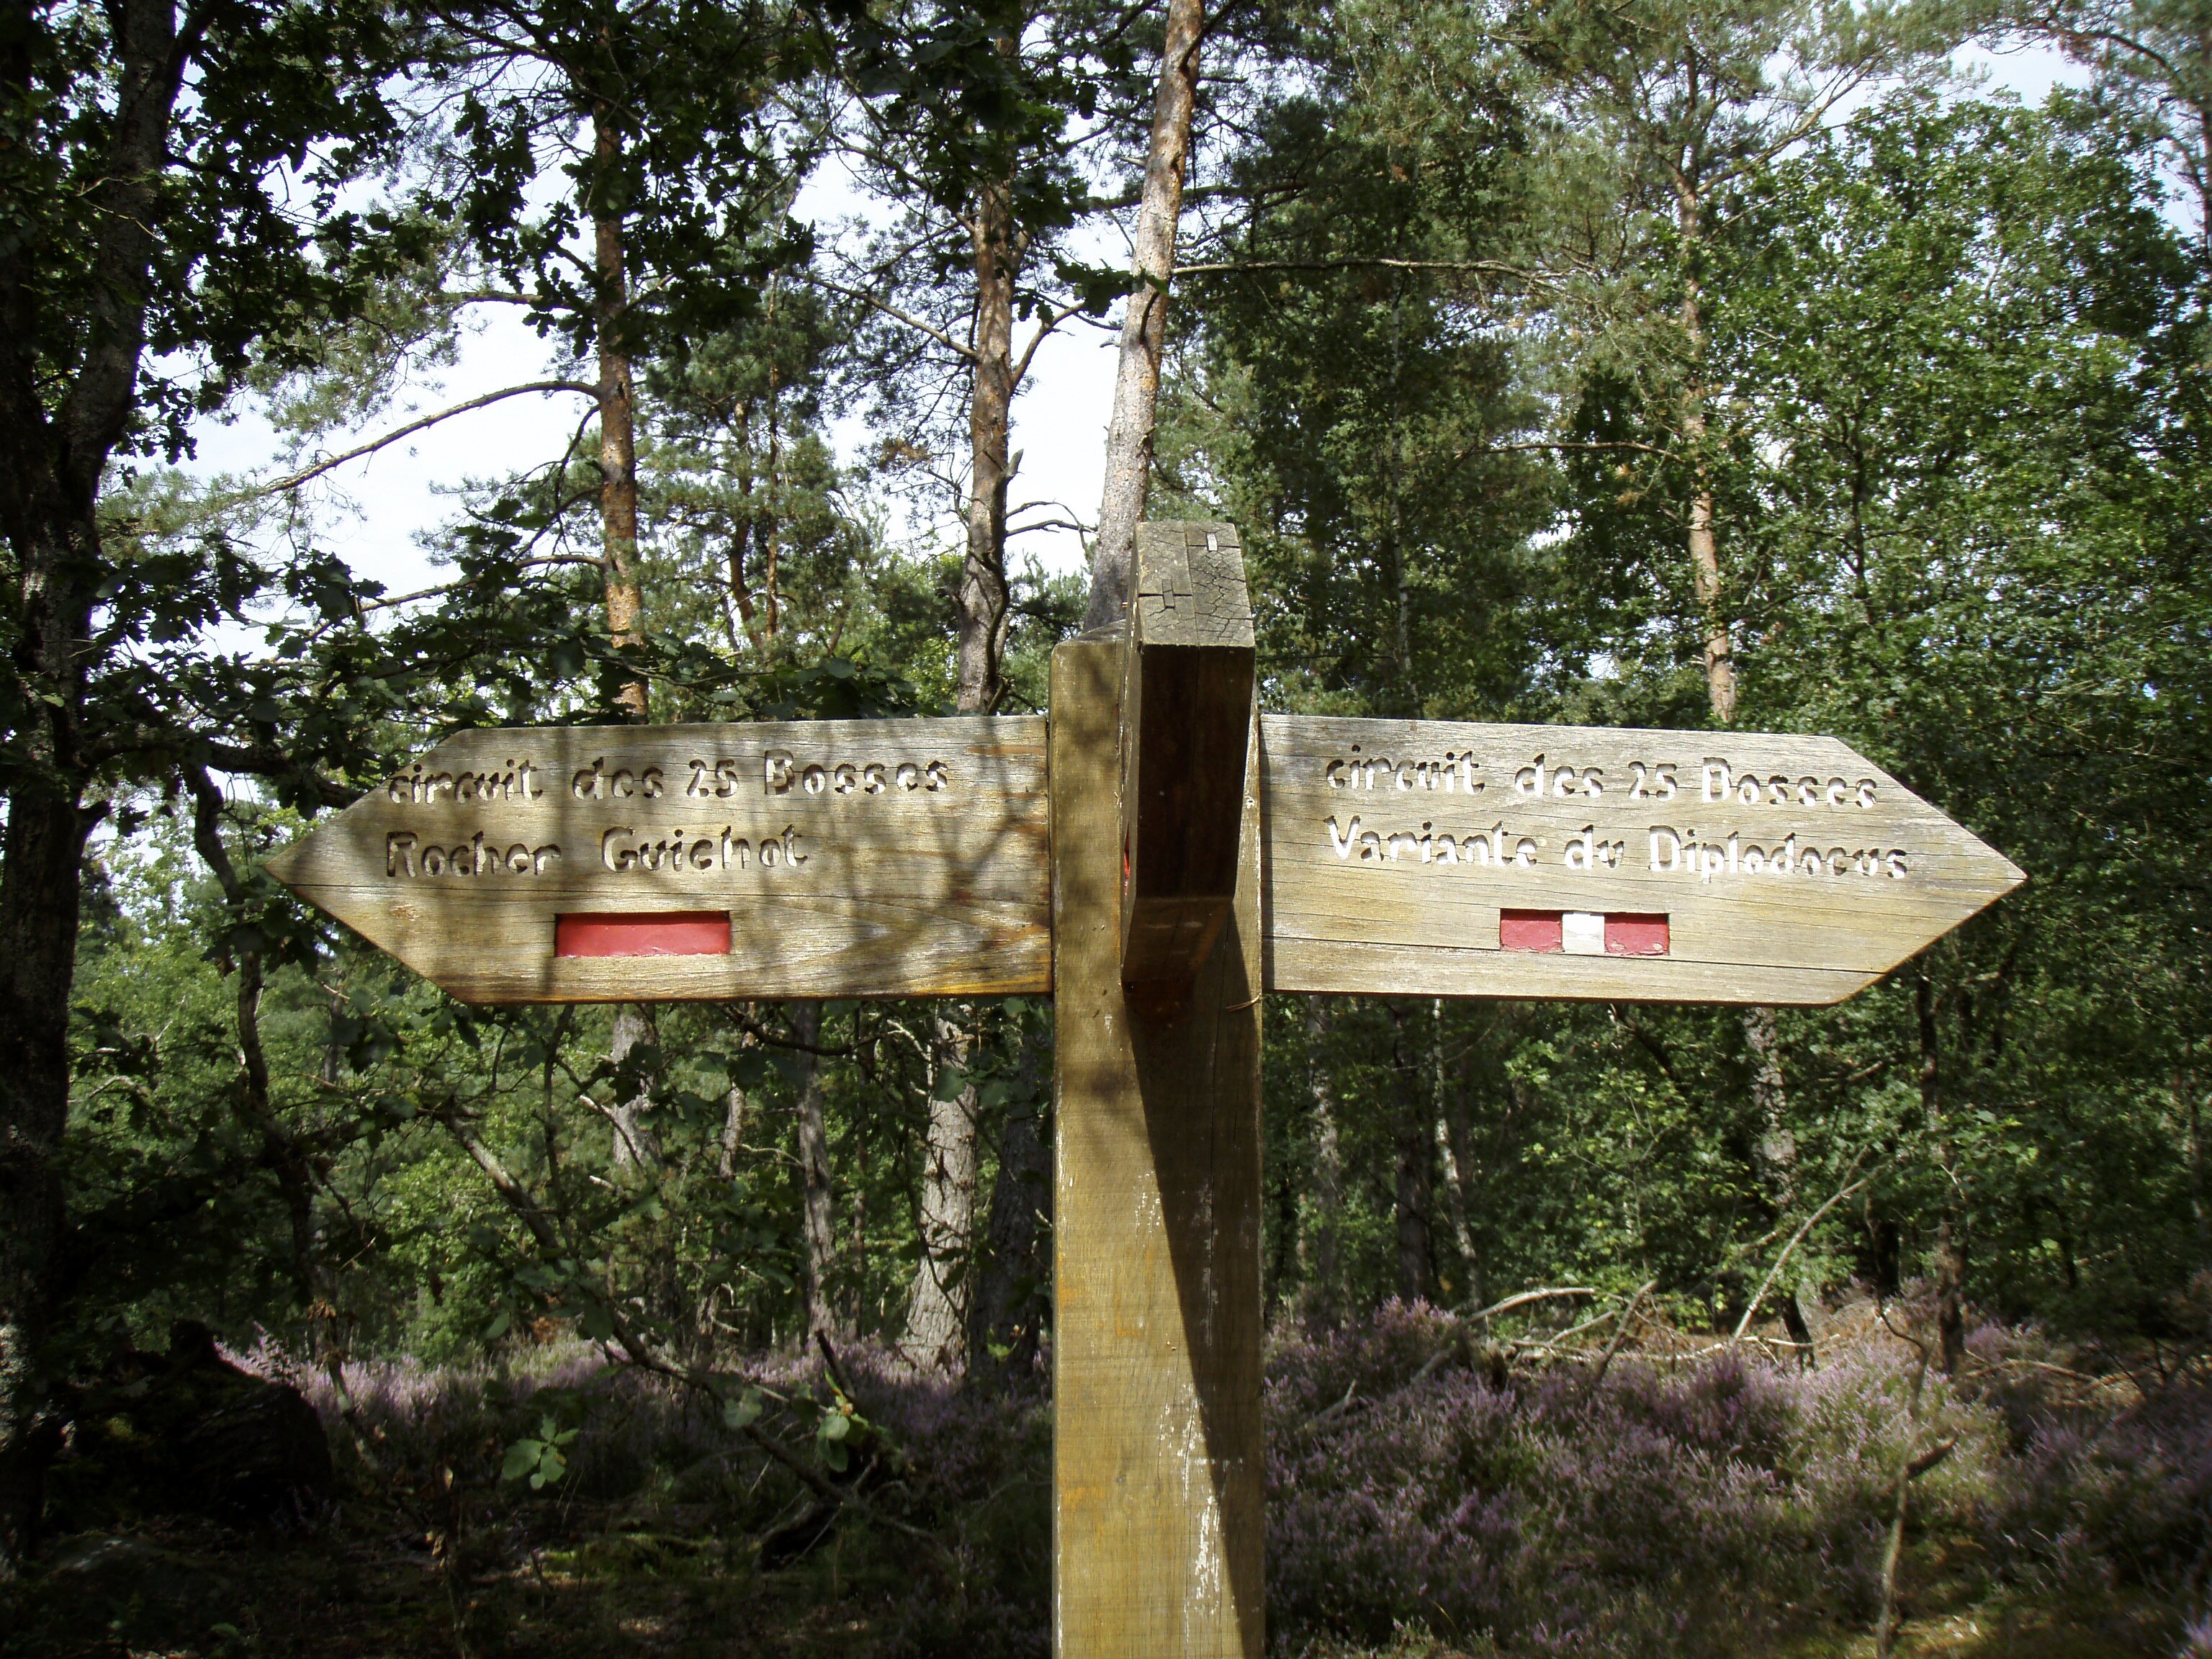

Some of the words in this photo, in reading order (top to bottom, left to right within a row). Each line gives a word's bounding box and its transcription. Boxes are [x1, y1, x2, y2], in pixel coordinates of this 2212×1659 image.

[389, 758, 544, 804] circuit
[572, 756, 664, 800] des
[687, 758, 739, 798] 25
[764, 749, 948, 795] Bosses
[1326, 744, 1485, 795] circuit
[1514, 753, 1604, 799] des
[1627, 760, 1678, 802] 25
[1701, 756, 1877, 809] Bosses
[386, 830, 562, 878] Rocher
[602, 824, 808, 873] Guichot
[1323, 814, 1538, 868] Variante
[1564, 824, 1625, 870] du
[1647, 824, 1908, 885] Diplodocus
